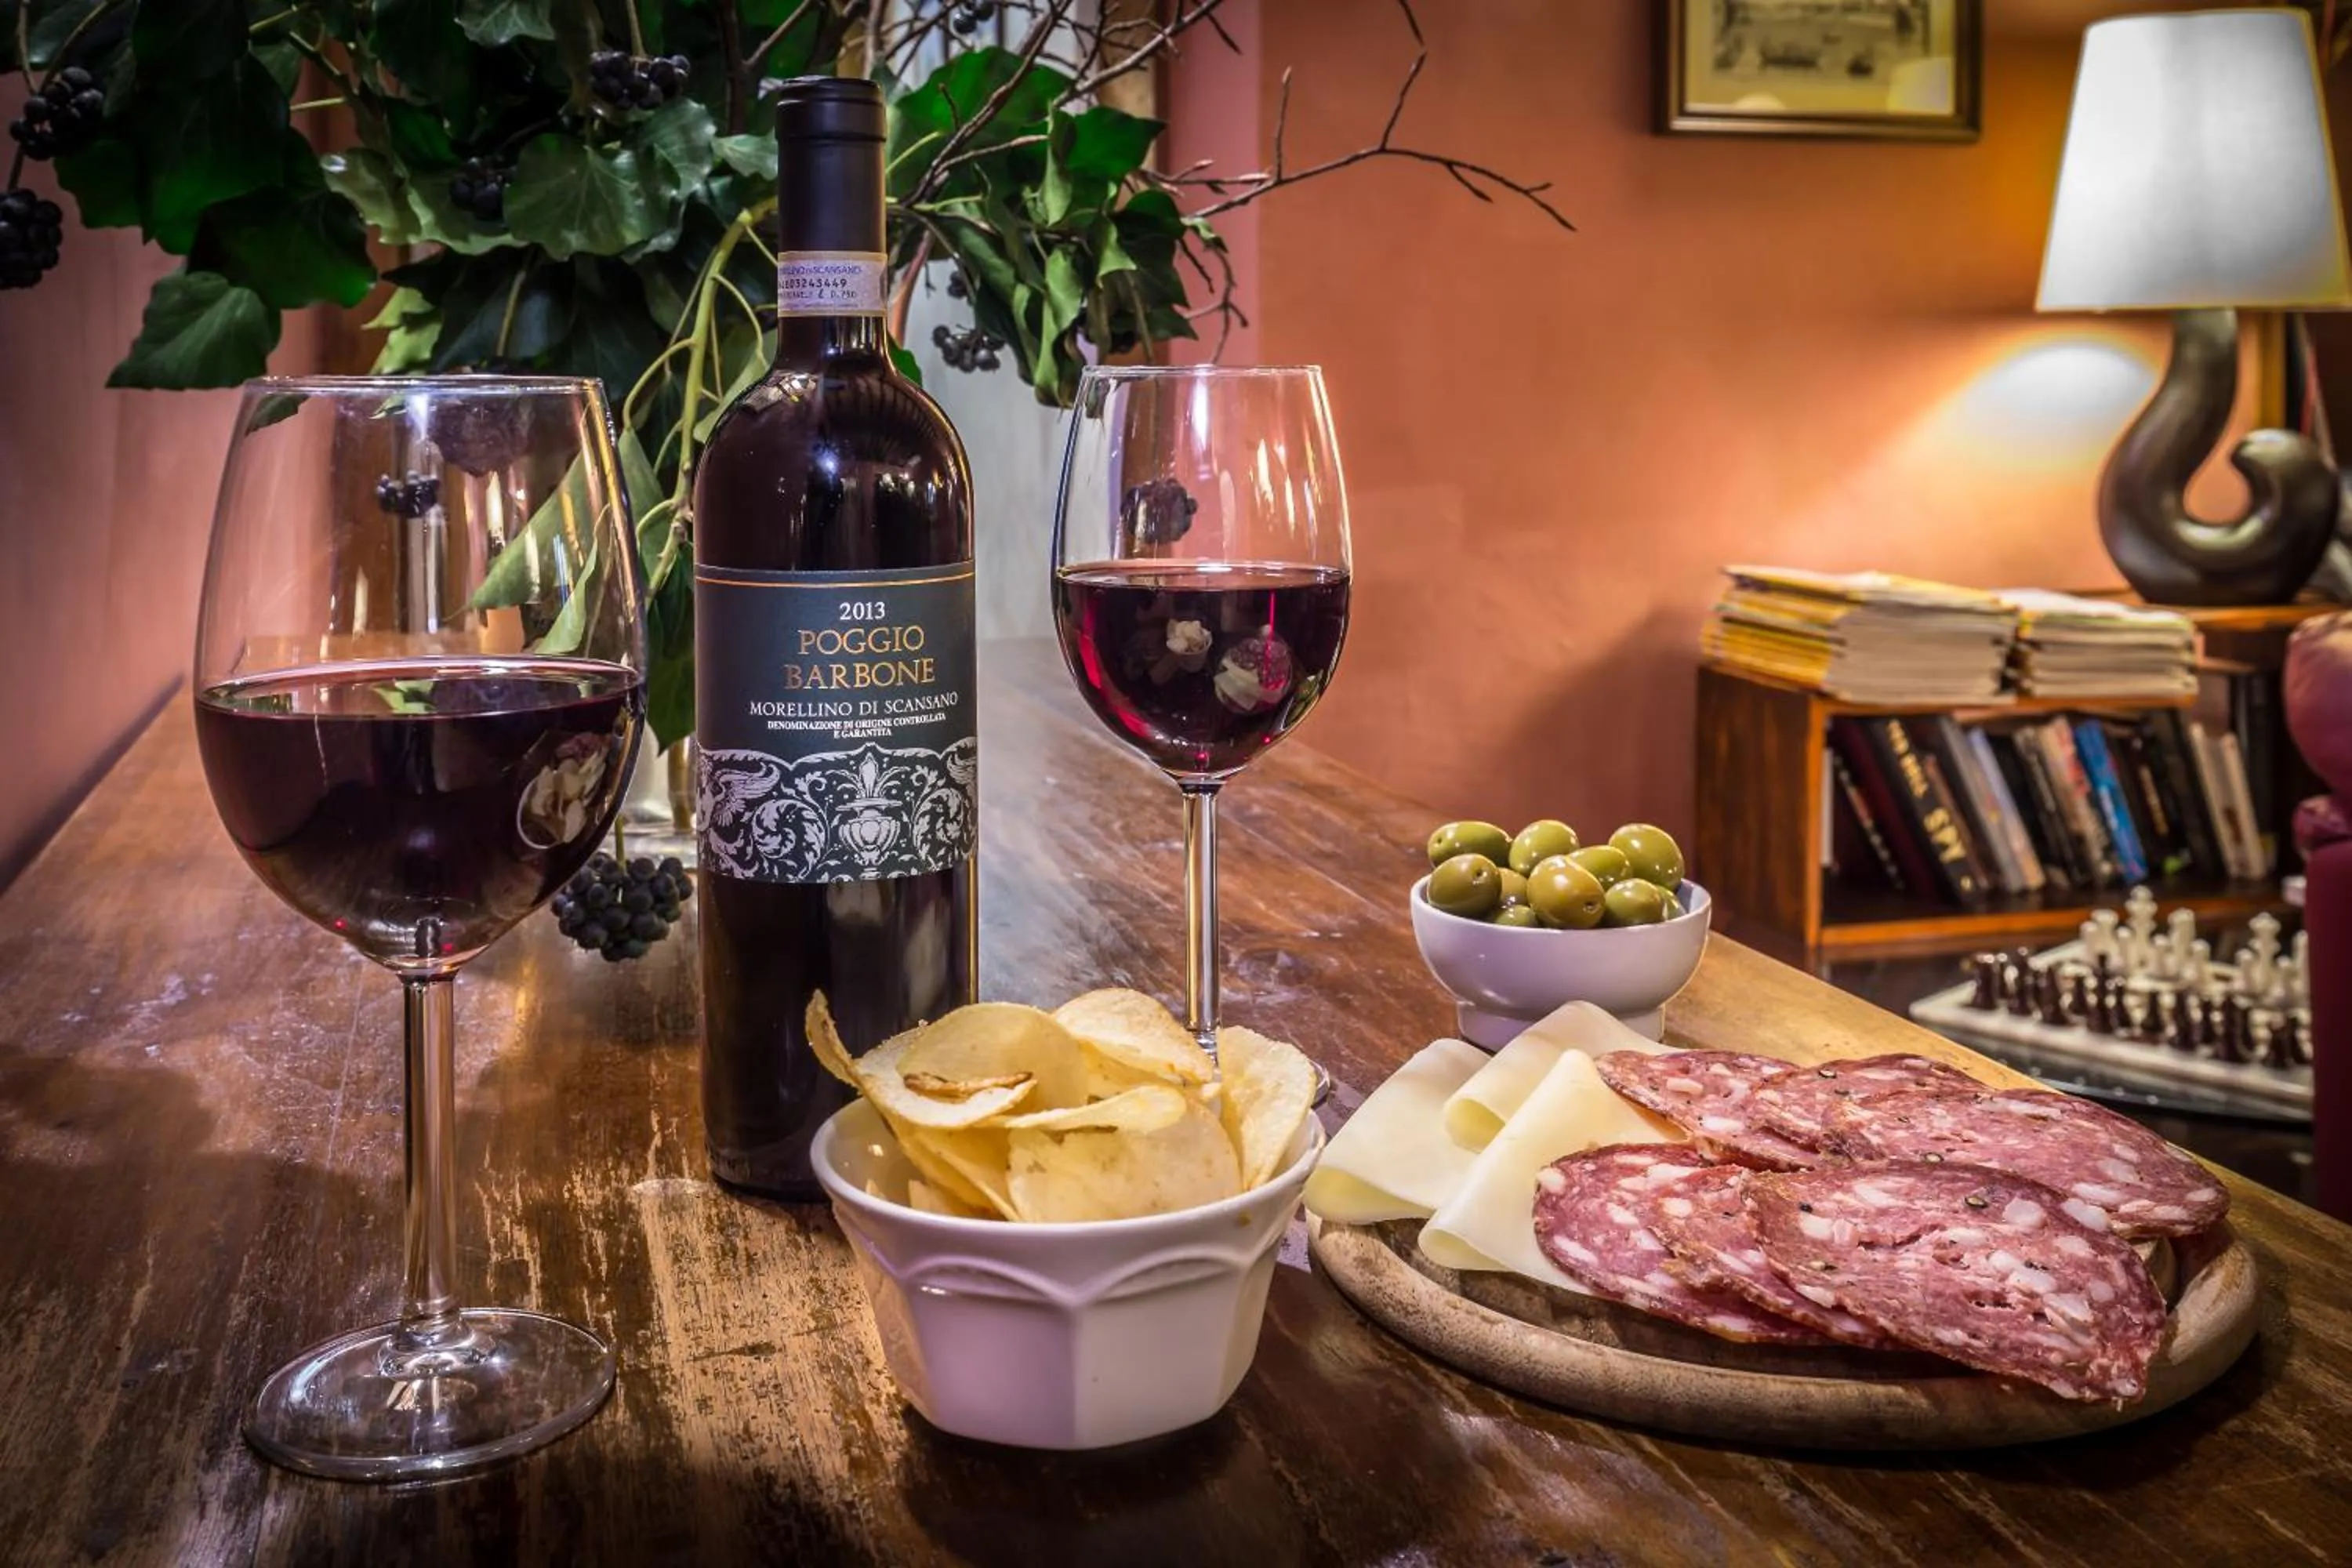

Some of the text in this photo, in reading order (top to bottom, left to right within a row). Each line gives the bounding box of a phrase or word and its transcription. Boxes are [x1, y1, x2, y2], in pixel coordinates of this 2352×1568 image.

[840, 601, 886, 620] 2013
[797, 625, 925, 655] POGGIO
[785, 658, 935, 689] BARBONE
[750, 691, 958, 717] MORELLINO DI SCANSANO
[768, 713, 946, 730] DENOMINAZIONE DI ORIGINE CONTROLLATA
[833, 728, 891, 739] E GARANTITA
